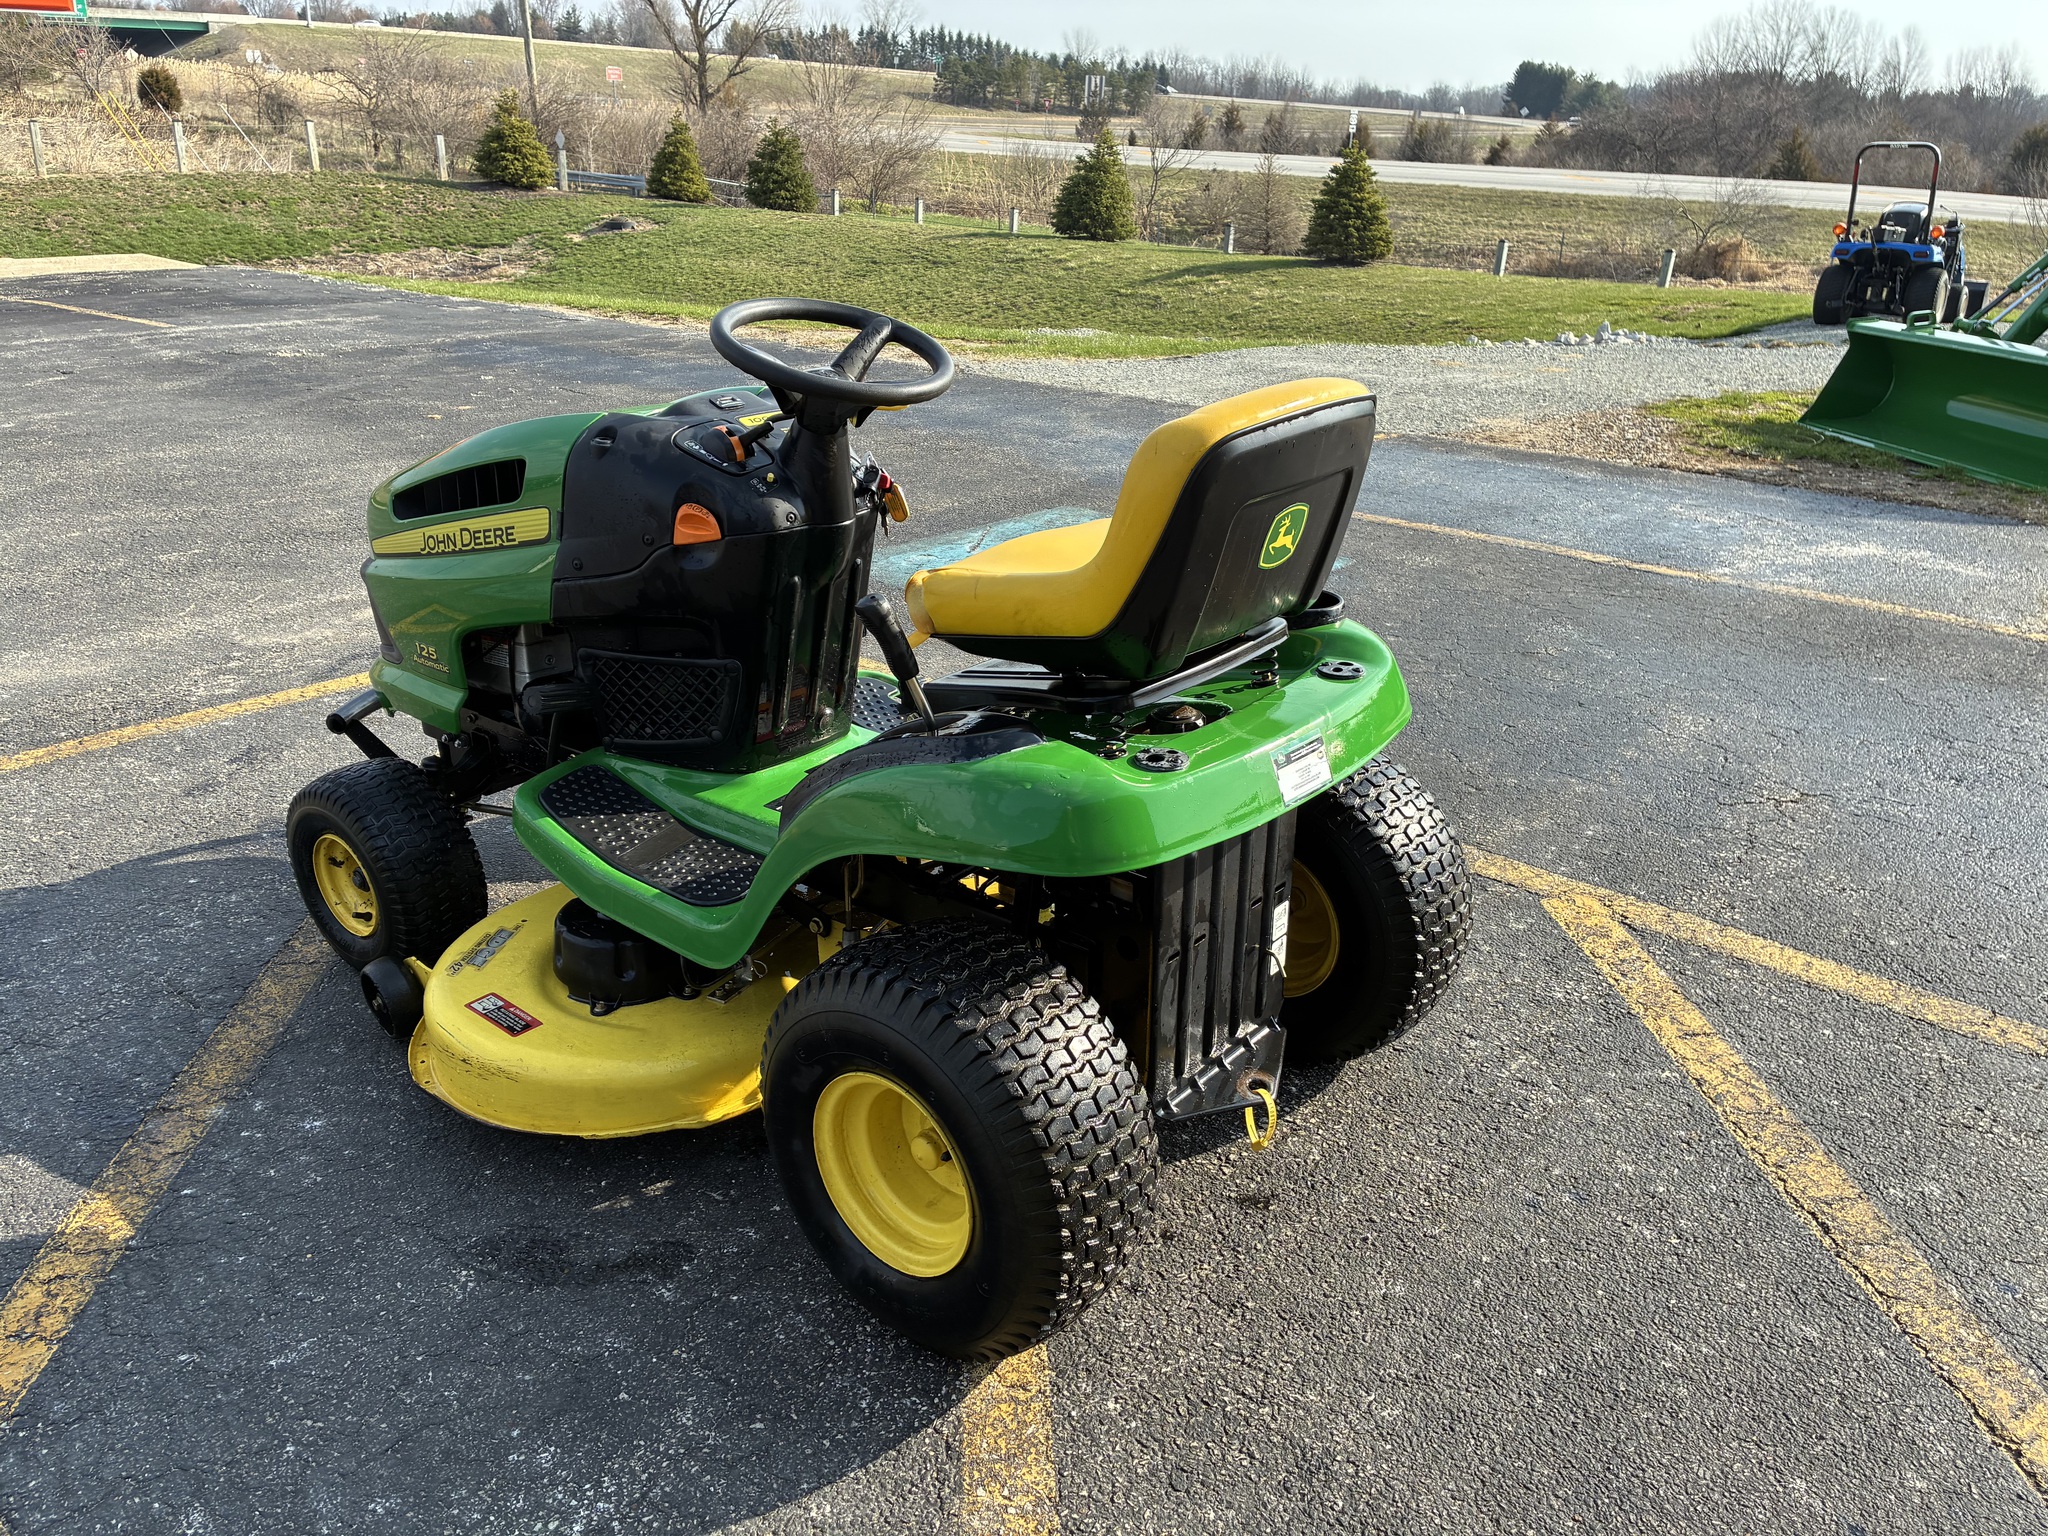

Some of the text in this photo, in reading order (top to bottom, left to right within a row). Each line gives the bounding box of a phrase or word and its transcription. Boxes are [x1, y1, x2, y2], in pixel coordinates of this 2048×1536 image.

[420, 525, 517, 552] JOHN DEERE
[415, 642, 437, 660] 125
[413, 654, 450, 673] Automatic
[467, 928, 515, 968] EDGE
